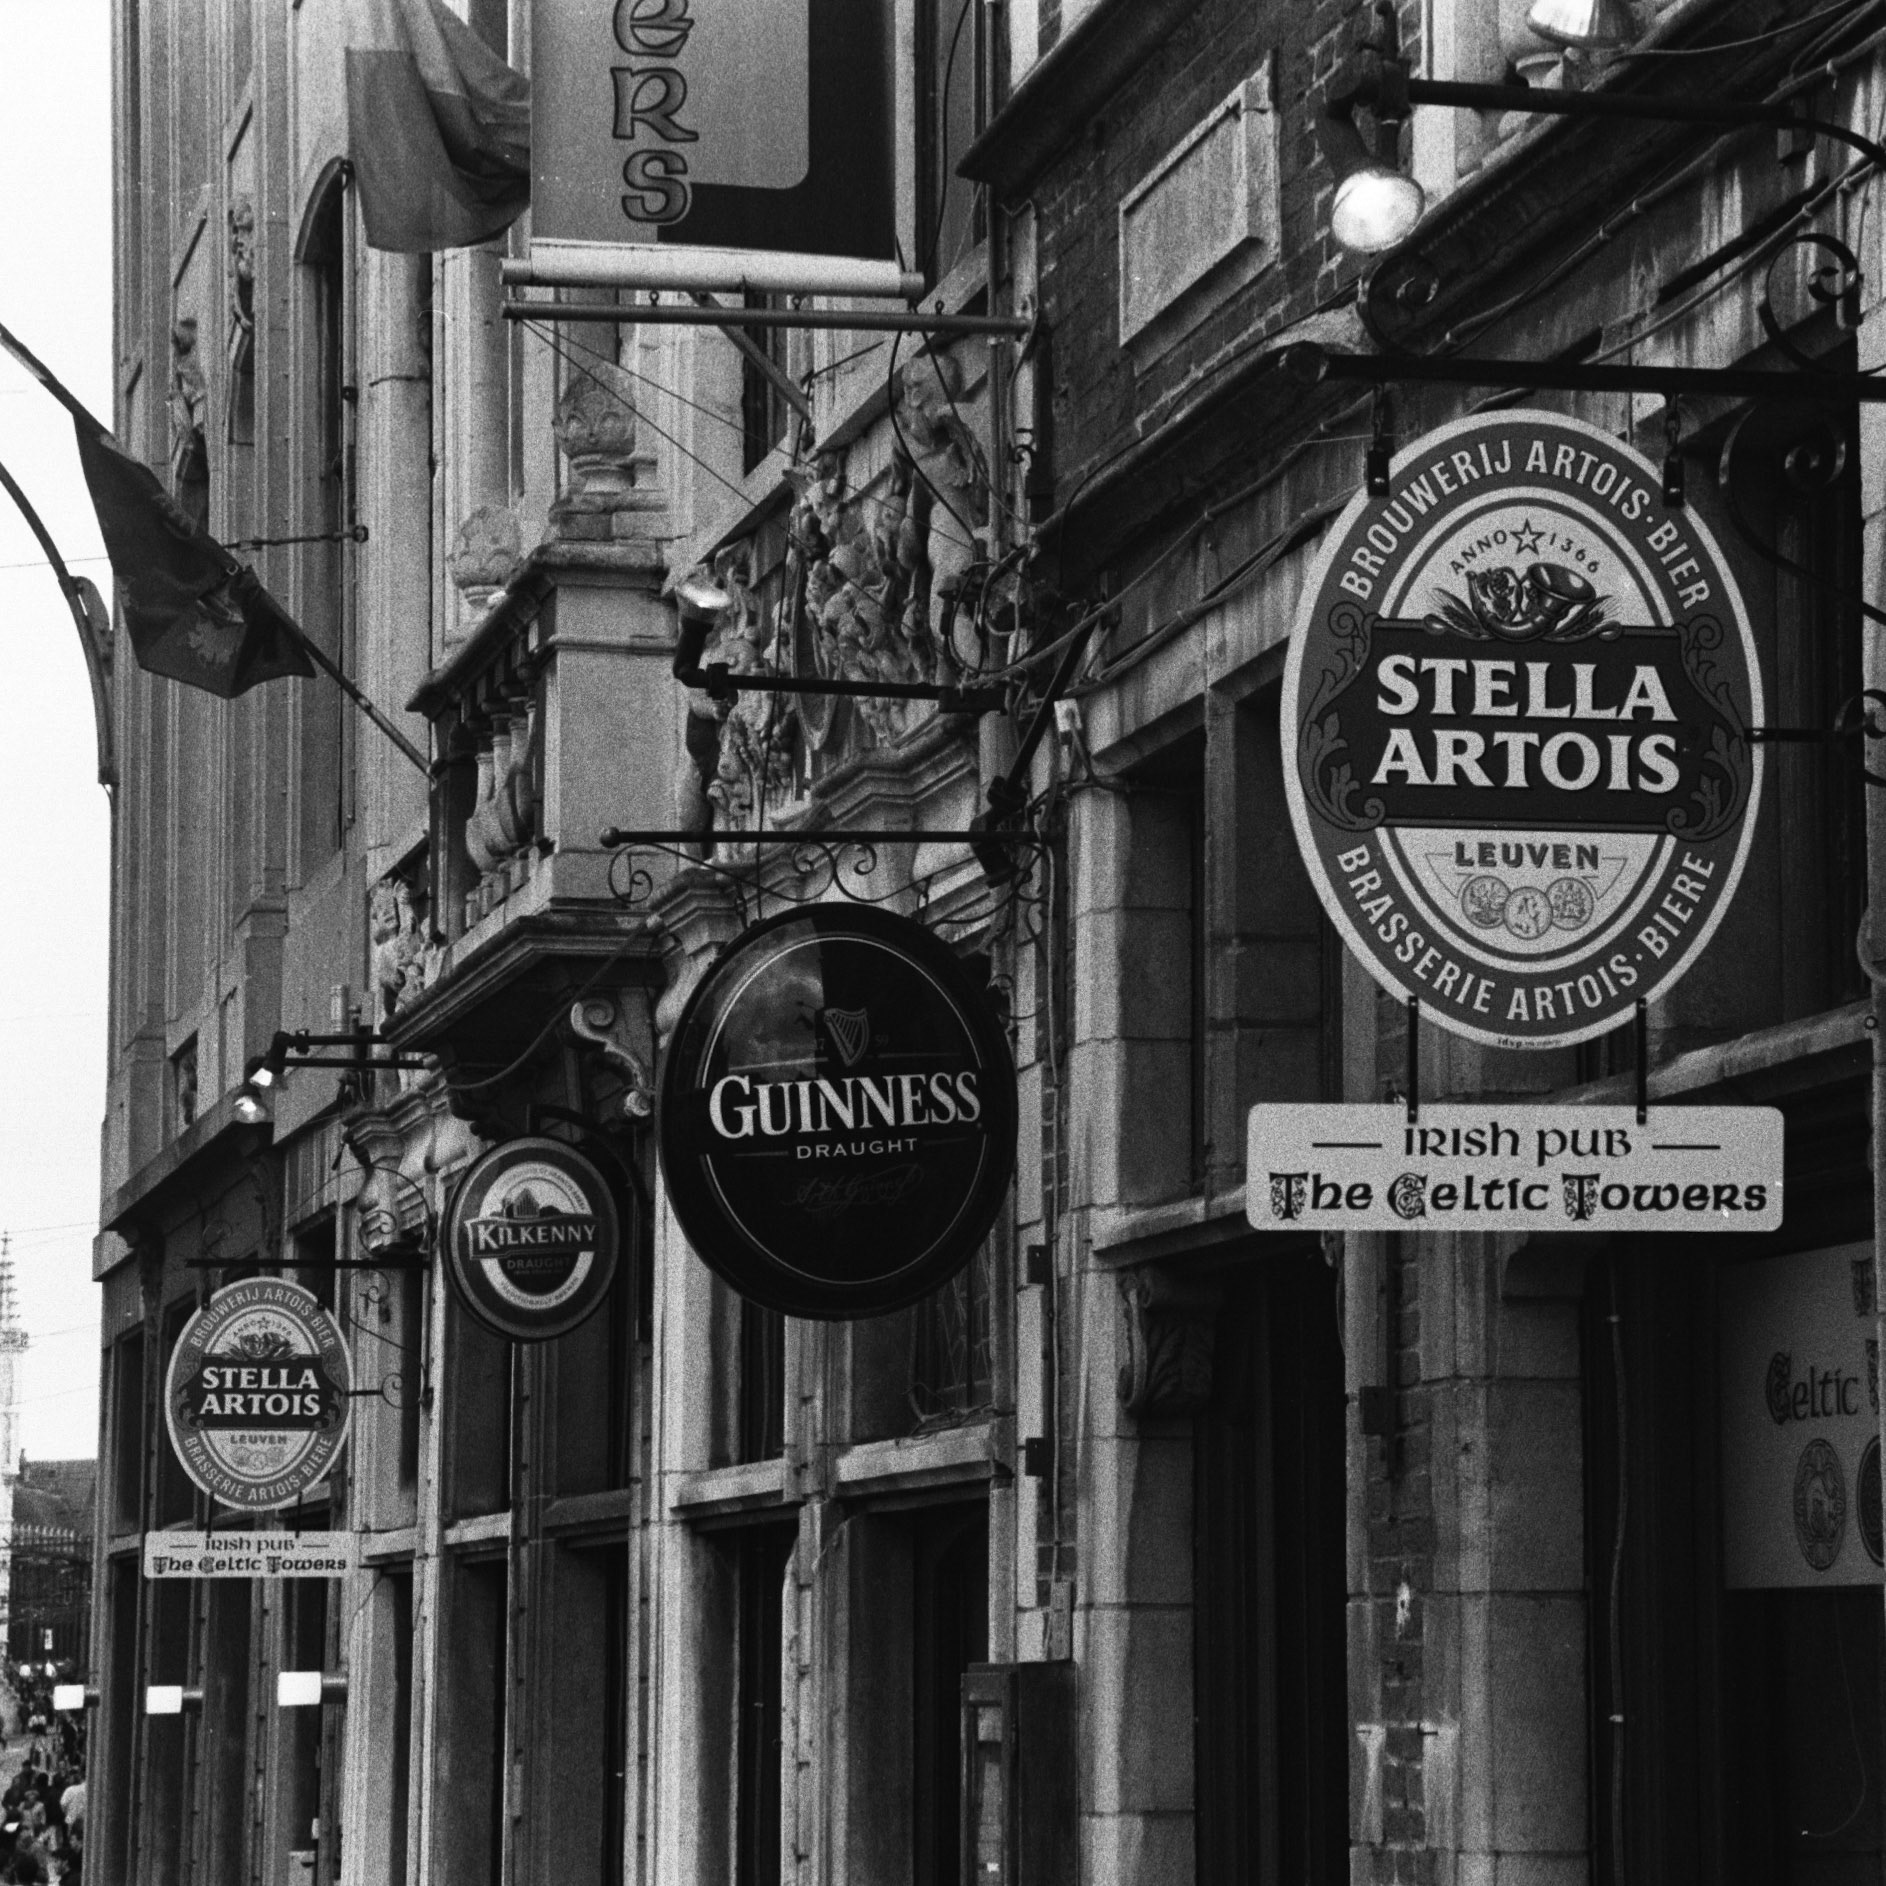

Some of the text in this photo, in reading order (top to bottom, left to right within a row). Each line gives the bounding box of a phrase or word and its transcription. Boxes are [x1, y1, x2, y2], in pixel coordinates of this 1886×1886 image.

[1340, 440, 1710, 611] BROUWERIJ ARTOIS BIER
[1449, 530, 1601, 577] ANNO 1366
[1376, 654, 1679, 722] STELLA
[1370, 728, 1681, 794] ARTOIS
[1455, 841, 1601, 870] LEUVEN
[1337, 844, 1715, 1022] BRASSERIE ARTOIS BIERE
[708, 1071, 981, 1140] GUINNESS
[796, 1138, 918, 1160] DRAUGHT
[1269, 1171, 1767, 1221] The Celtic Towers
[477, 1224, 596, 1250] KILKENNY
[507, 1257, 571, 1270] DRAUGHT
[190, 1287, 336, 1348] BROUWERIJ ARTOIS BIER
[202, 1366, 320, 1389] STELLA
[1765, 1350, 1859, 1425] Celtic
[200, 1394, 321, 1416] ARTOIS
[230, 1435, 287, 1445] LEUVEN
[185, 1437, 332, 1501] BRASSERIE ARTOIS BIERE
[153, 1556, 347, 1574] The Celtic Towers
